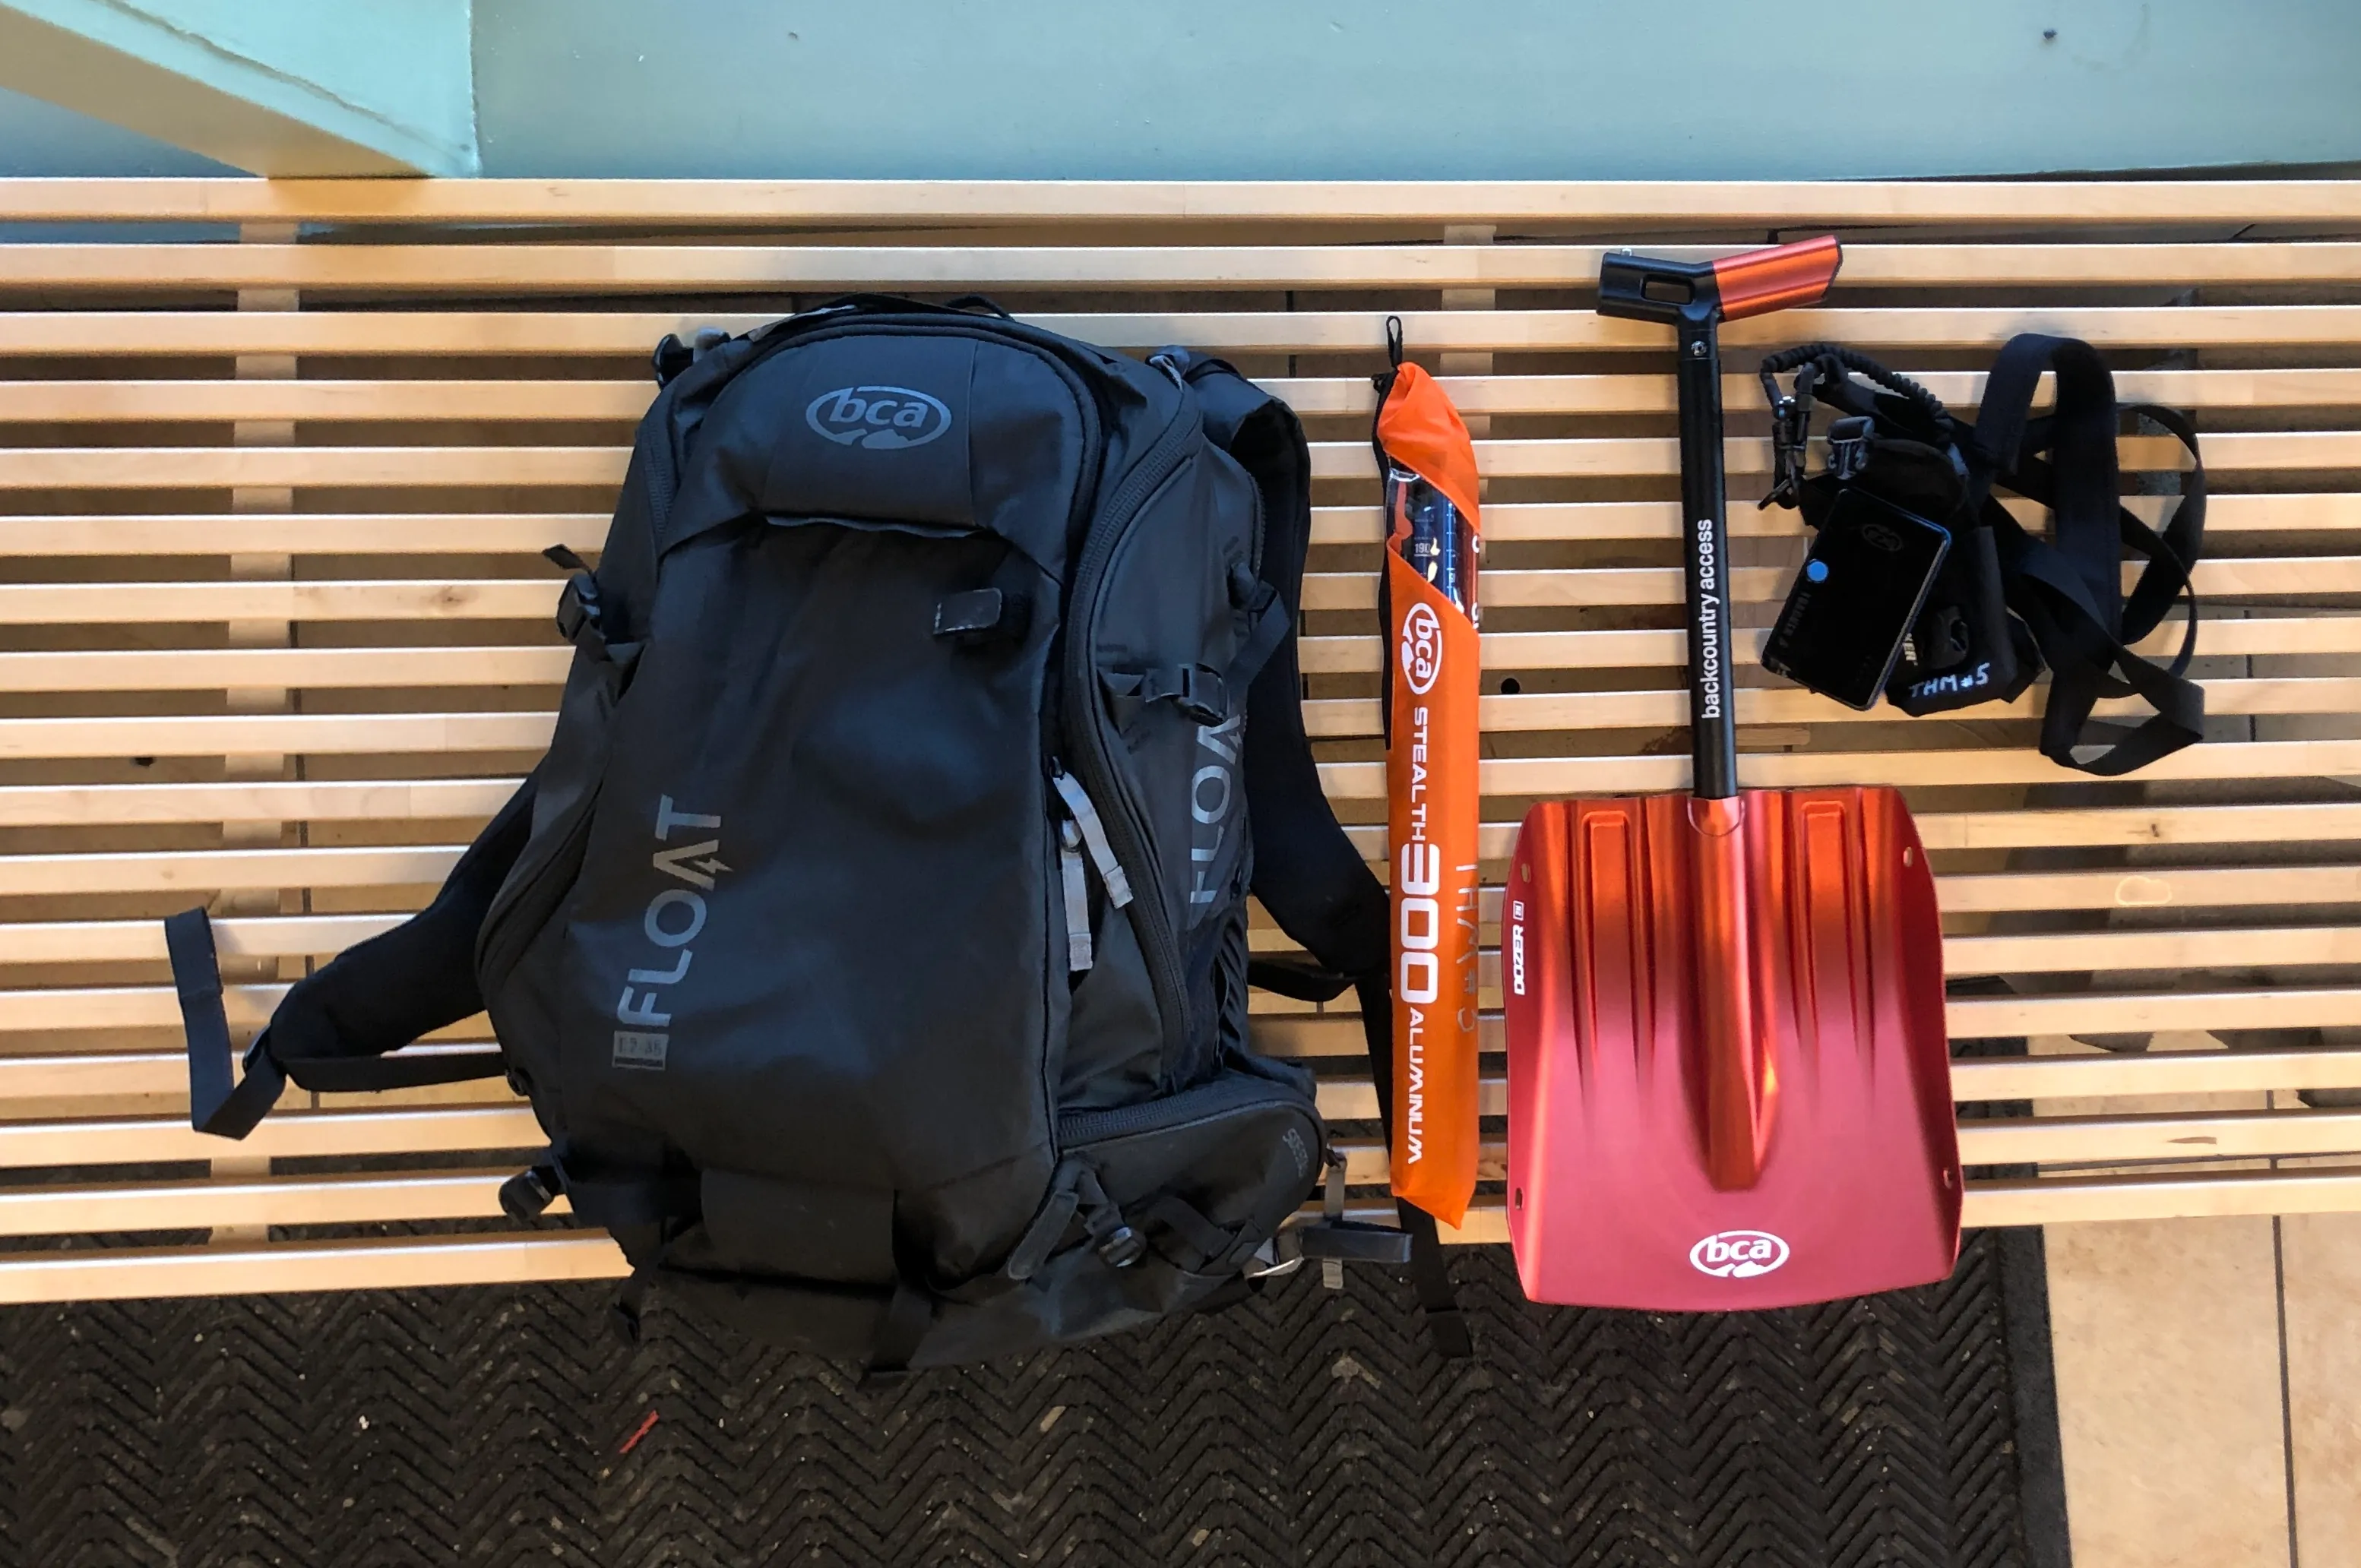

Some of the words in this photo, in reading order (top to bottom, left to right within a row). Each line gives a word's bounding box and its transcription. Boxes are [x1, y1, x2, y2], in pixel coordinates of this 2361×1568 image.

[826, 386, 932, 430] bca
[1697, 518, 1716, 590] access
[1415, 616, 1441, 680] bca
[1698, 593, 1721, 719] backcountry
[1410, 706, 1429, 842] STEALTH
[616, 792, 733, 1028] FLOAT
[1400, 843, 1440, 1004] 300
[1512, 924, 1526, 996] DOZER
[1407, 1007, 1425, 1165] ALUMINUM
[1705, 1234, 1774, 1263] bca
